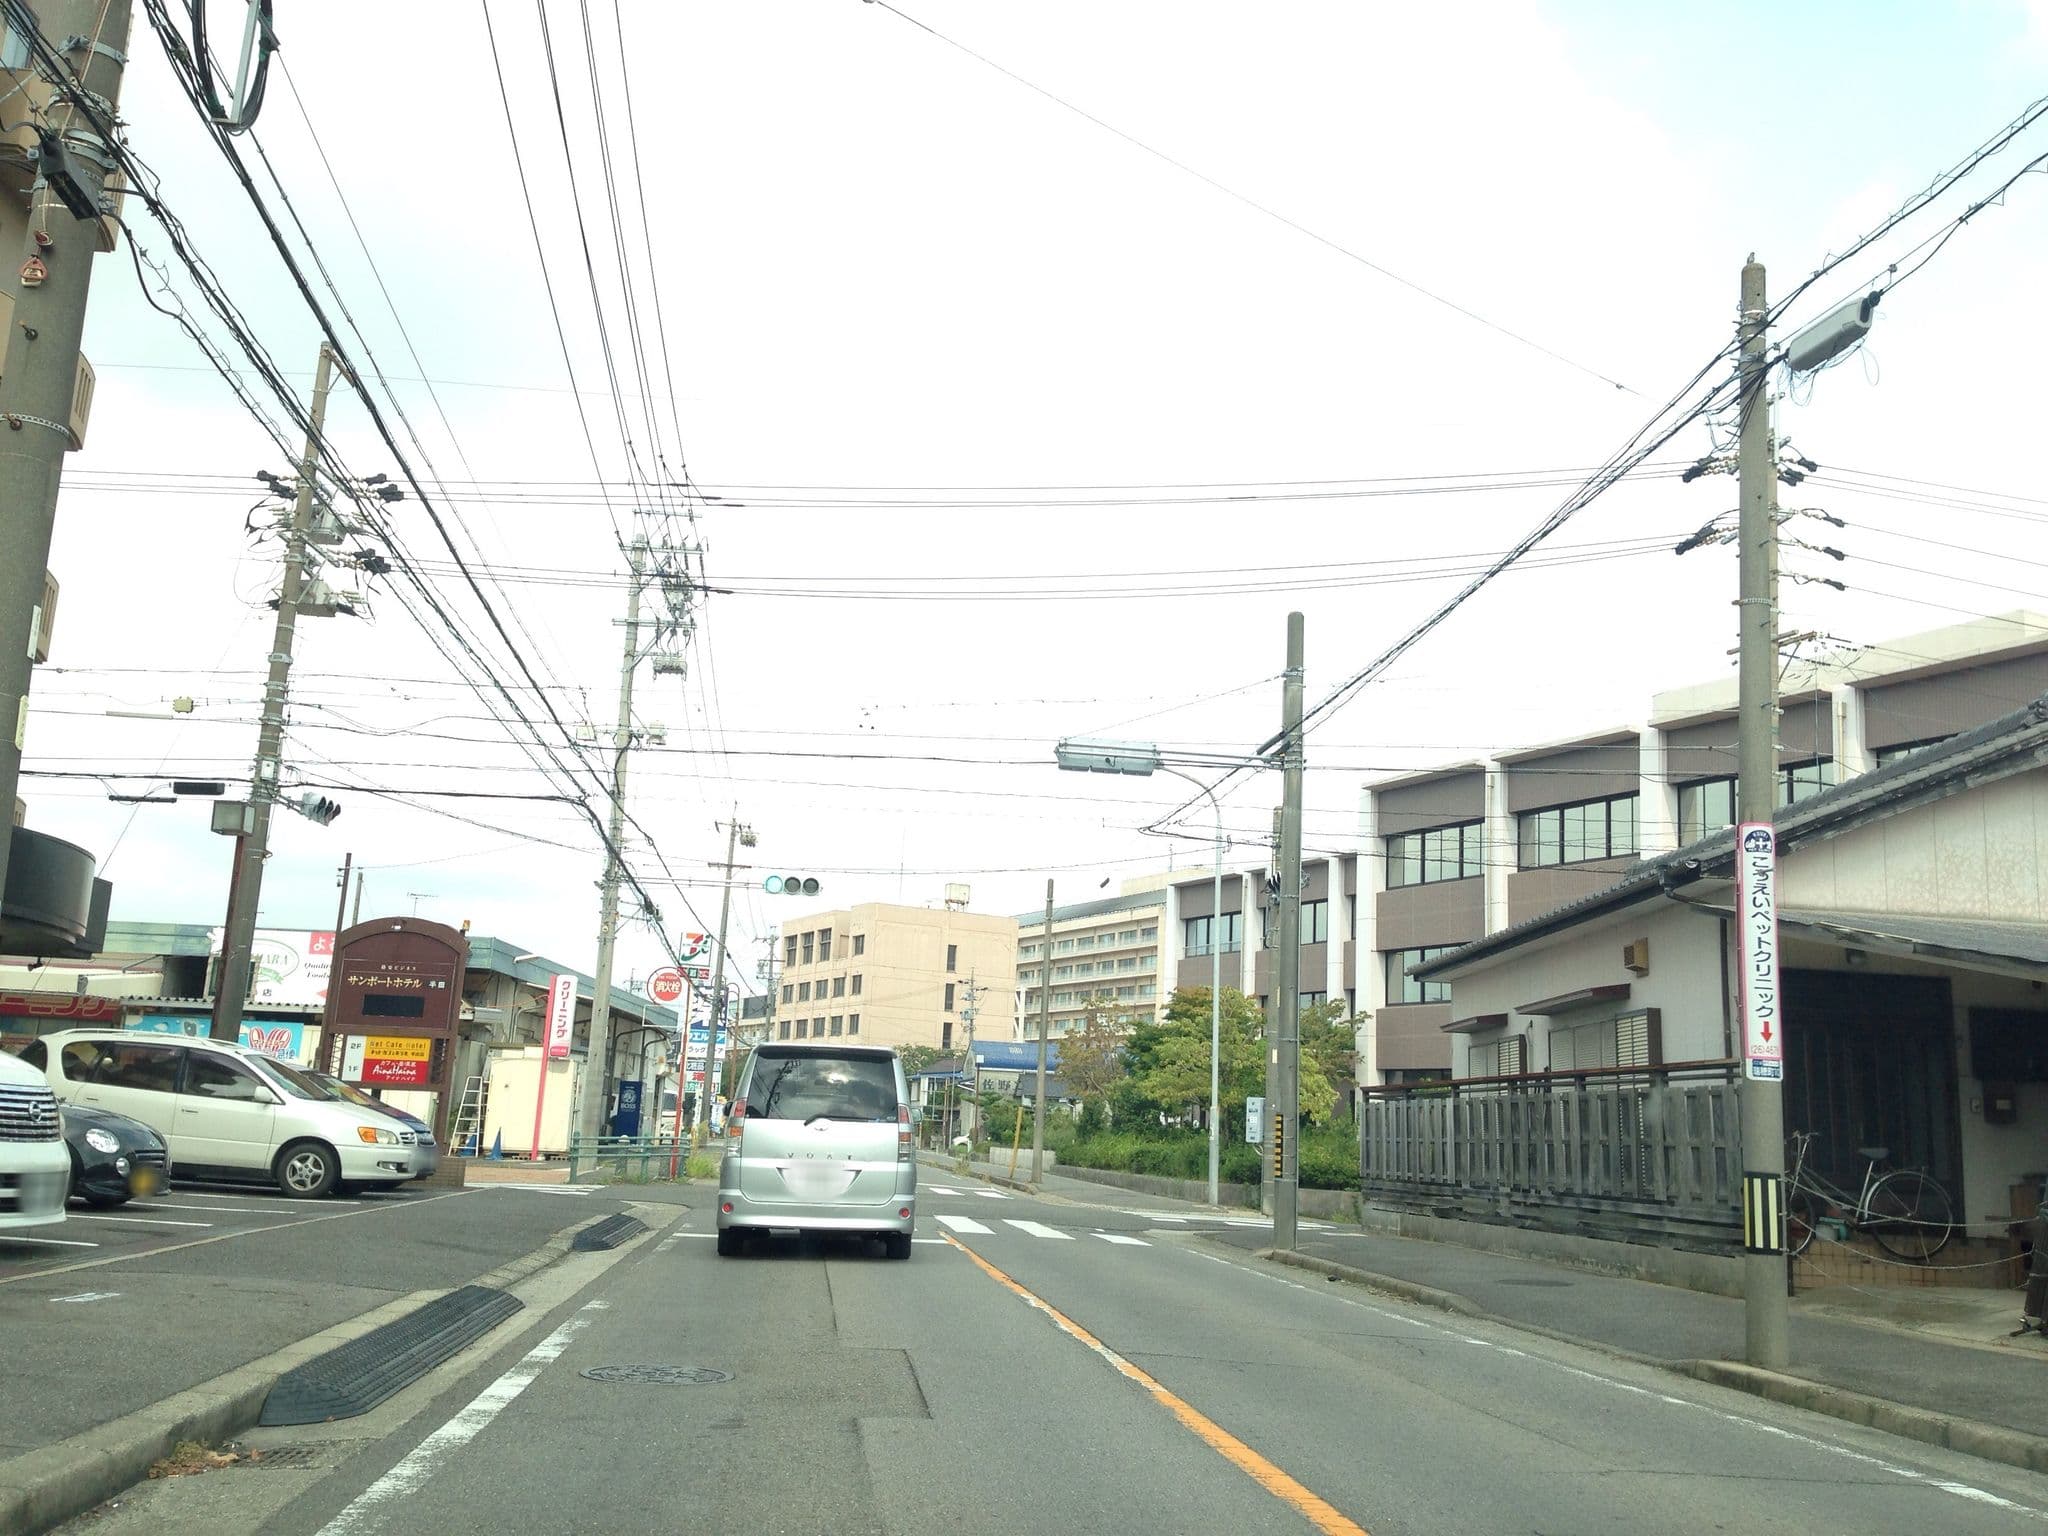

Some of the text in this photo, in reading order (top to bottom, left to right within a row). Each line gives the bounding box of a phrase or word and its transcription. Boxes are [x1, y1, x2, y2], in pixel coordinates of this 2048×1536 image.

[1751, 856, 1775, 1018] こうえいペットクリニック
[556, 981, 571, 1039] クリーニング
[655, 980, 681, 994] 消火栓
